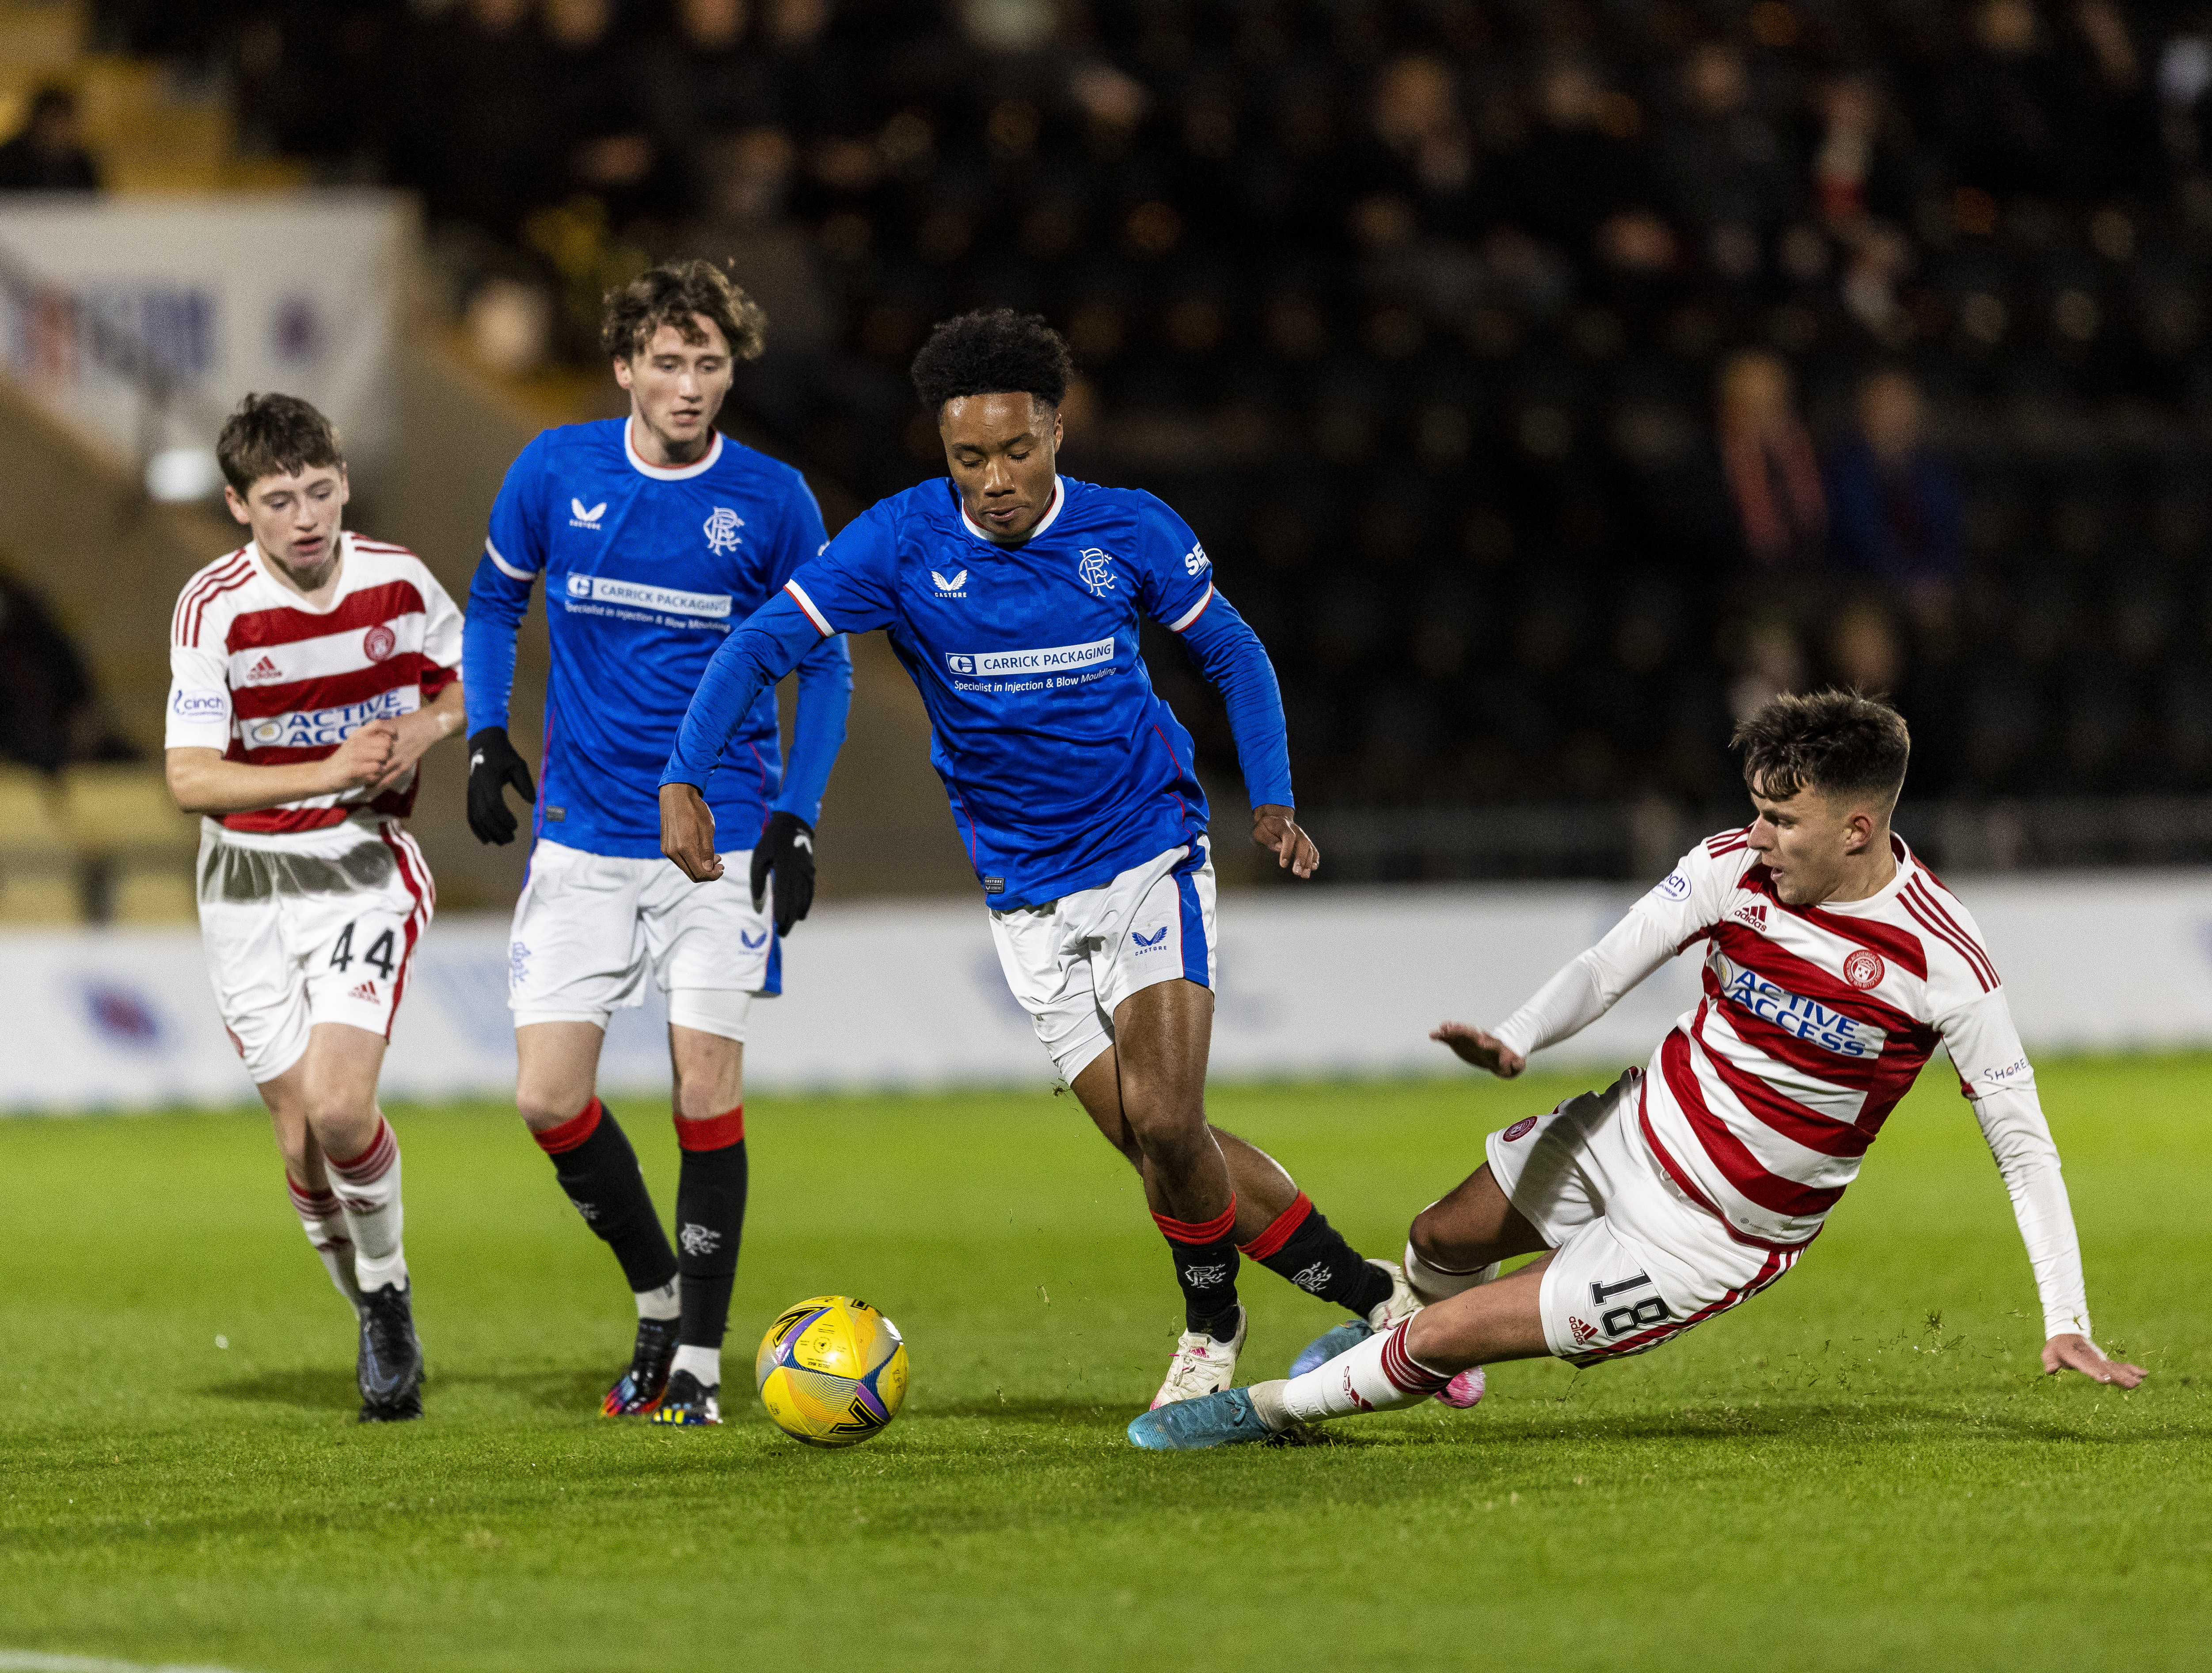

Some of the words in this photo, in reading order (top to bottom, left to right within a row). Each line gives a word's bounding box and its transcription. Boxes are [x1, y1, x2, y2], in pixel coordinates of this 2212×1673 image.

[601, 584, 653, 603] CARRICK
[984, 656, 1040, 670] CARRICK
[1044, 644, 1111, 666] PACKAGING
[954, 680, 992, 692] Specialist
[994, 683, 1002, 692] in
[1005, 681, 1043, 694] Injection
[1046, 678, 1053, 688] &
[1057, 676, 1079, 687] Blow
[1081, 668, 1116, 683] Moulding
[288, 690, 401, 728] ACTIVE
[1734, 910, 1767, 932] adidas
[329, 920, 395, 980] 44
[1135, 945, 1167, 956] CASTORE
[1734, 969, 1859, 1039] ACTIVE
[1732, 988, 1866, 1056] ACCESS
[1984, 1058, 2030, 1081] SHORE
[1589, 1268, 1671, 1339] 18
[1569, 1316, 1586, 1346] adidas
